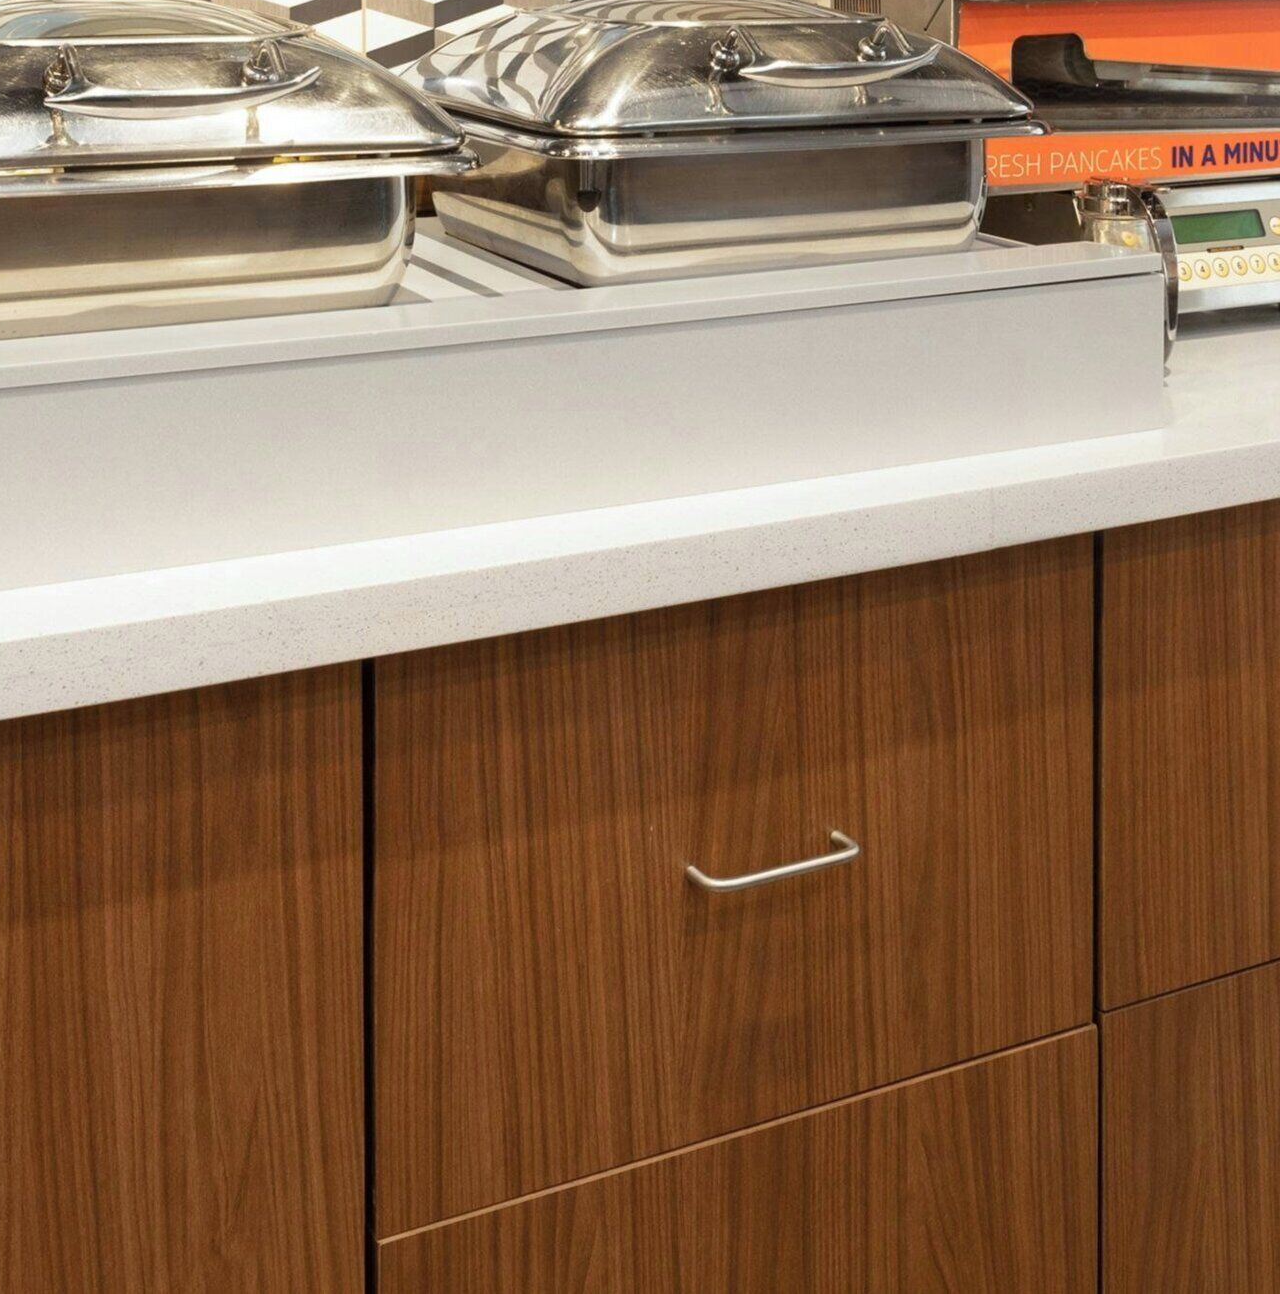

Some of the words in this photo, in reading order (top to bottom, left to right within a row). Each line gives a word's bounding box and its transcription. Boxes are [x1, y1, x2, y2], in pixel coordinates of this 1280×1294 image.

[987, 153, 1041, 178] RESH
[1050, 147, 1162, 175] PANCAKES
[1172, 145, 1194, 168] IN
[1201, 145, 1216, 166] A
